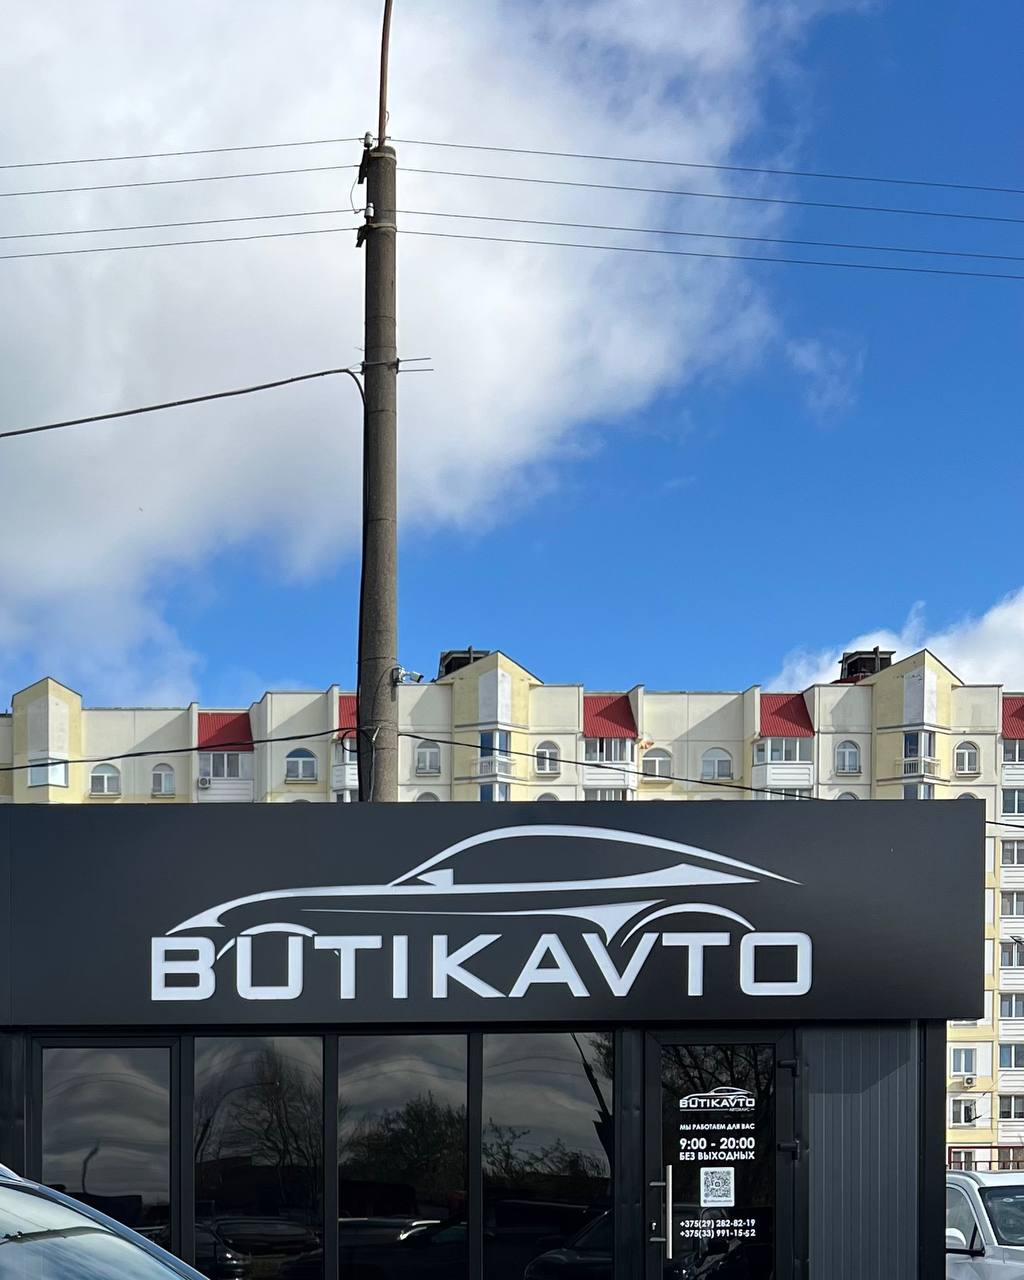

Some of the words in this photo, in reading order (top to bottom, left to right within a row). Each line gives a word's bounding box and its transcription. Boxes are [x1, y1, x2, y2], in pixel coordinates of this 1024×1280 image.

[151, 931, 813, 1001] BUTIKAVTO
[679, 1098, 755, 1108] BUTIKAVTO
[692, 1123, 726, 1131] РАБОТАЕМ
[679, 1137, 707, 1150] 9:00
[719, 1137, 755, 1150] 20:00
[679, 1152, 696, 1160] БЕЗ
[697, 1151, 755, 1160] ВЫХОДНЫХ
[680, 1219, 714, 1229] +375(29)
[716, 1219, 756, 1228] 282-82-19
[680, 1229, 714, 1239] +375(33)
[716, 1229, 756, 1238] 991-15-52
